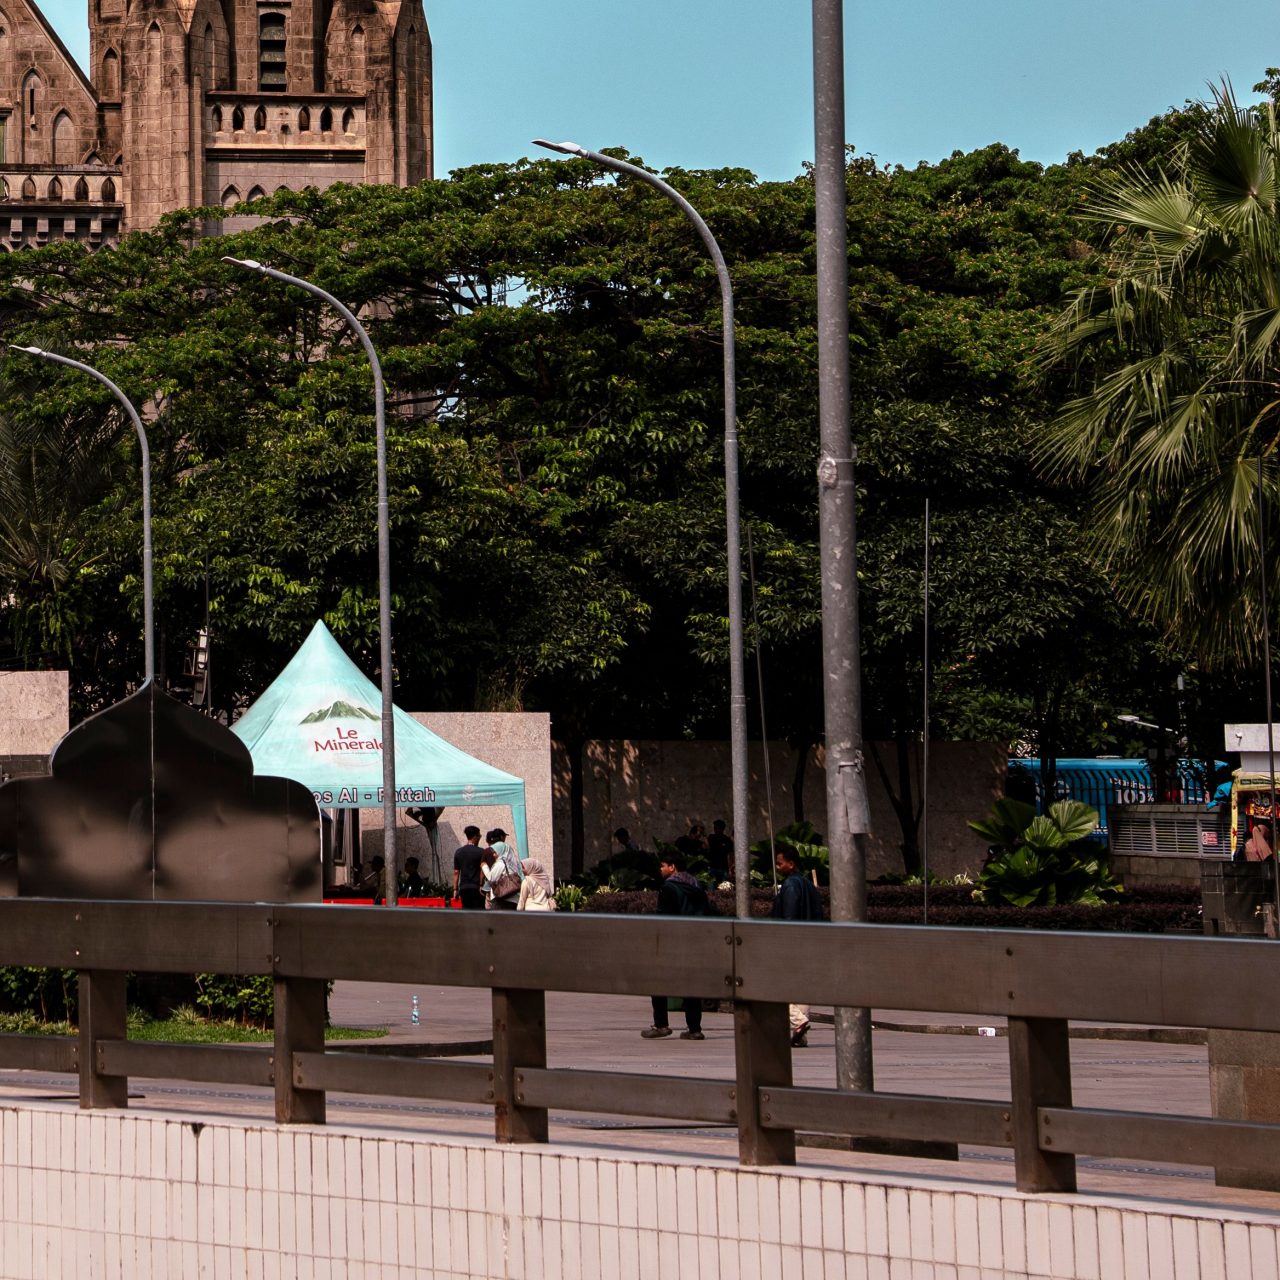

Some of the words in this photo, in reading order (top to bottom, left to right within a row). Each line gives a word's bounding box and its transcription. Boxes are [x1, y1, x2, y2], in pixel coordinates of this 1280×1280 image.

[336, 727, 359, 740] Le
[312, 790, 333, 803] os
[338, 787, 358, 803] Al
[377, 786, 436, 803] Fttah
